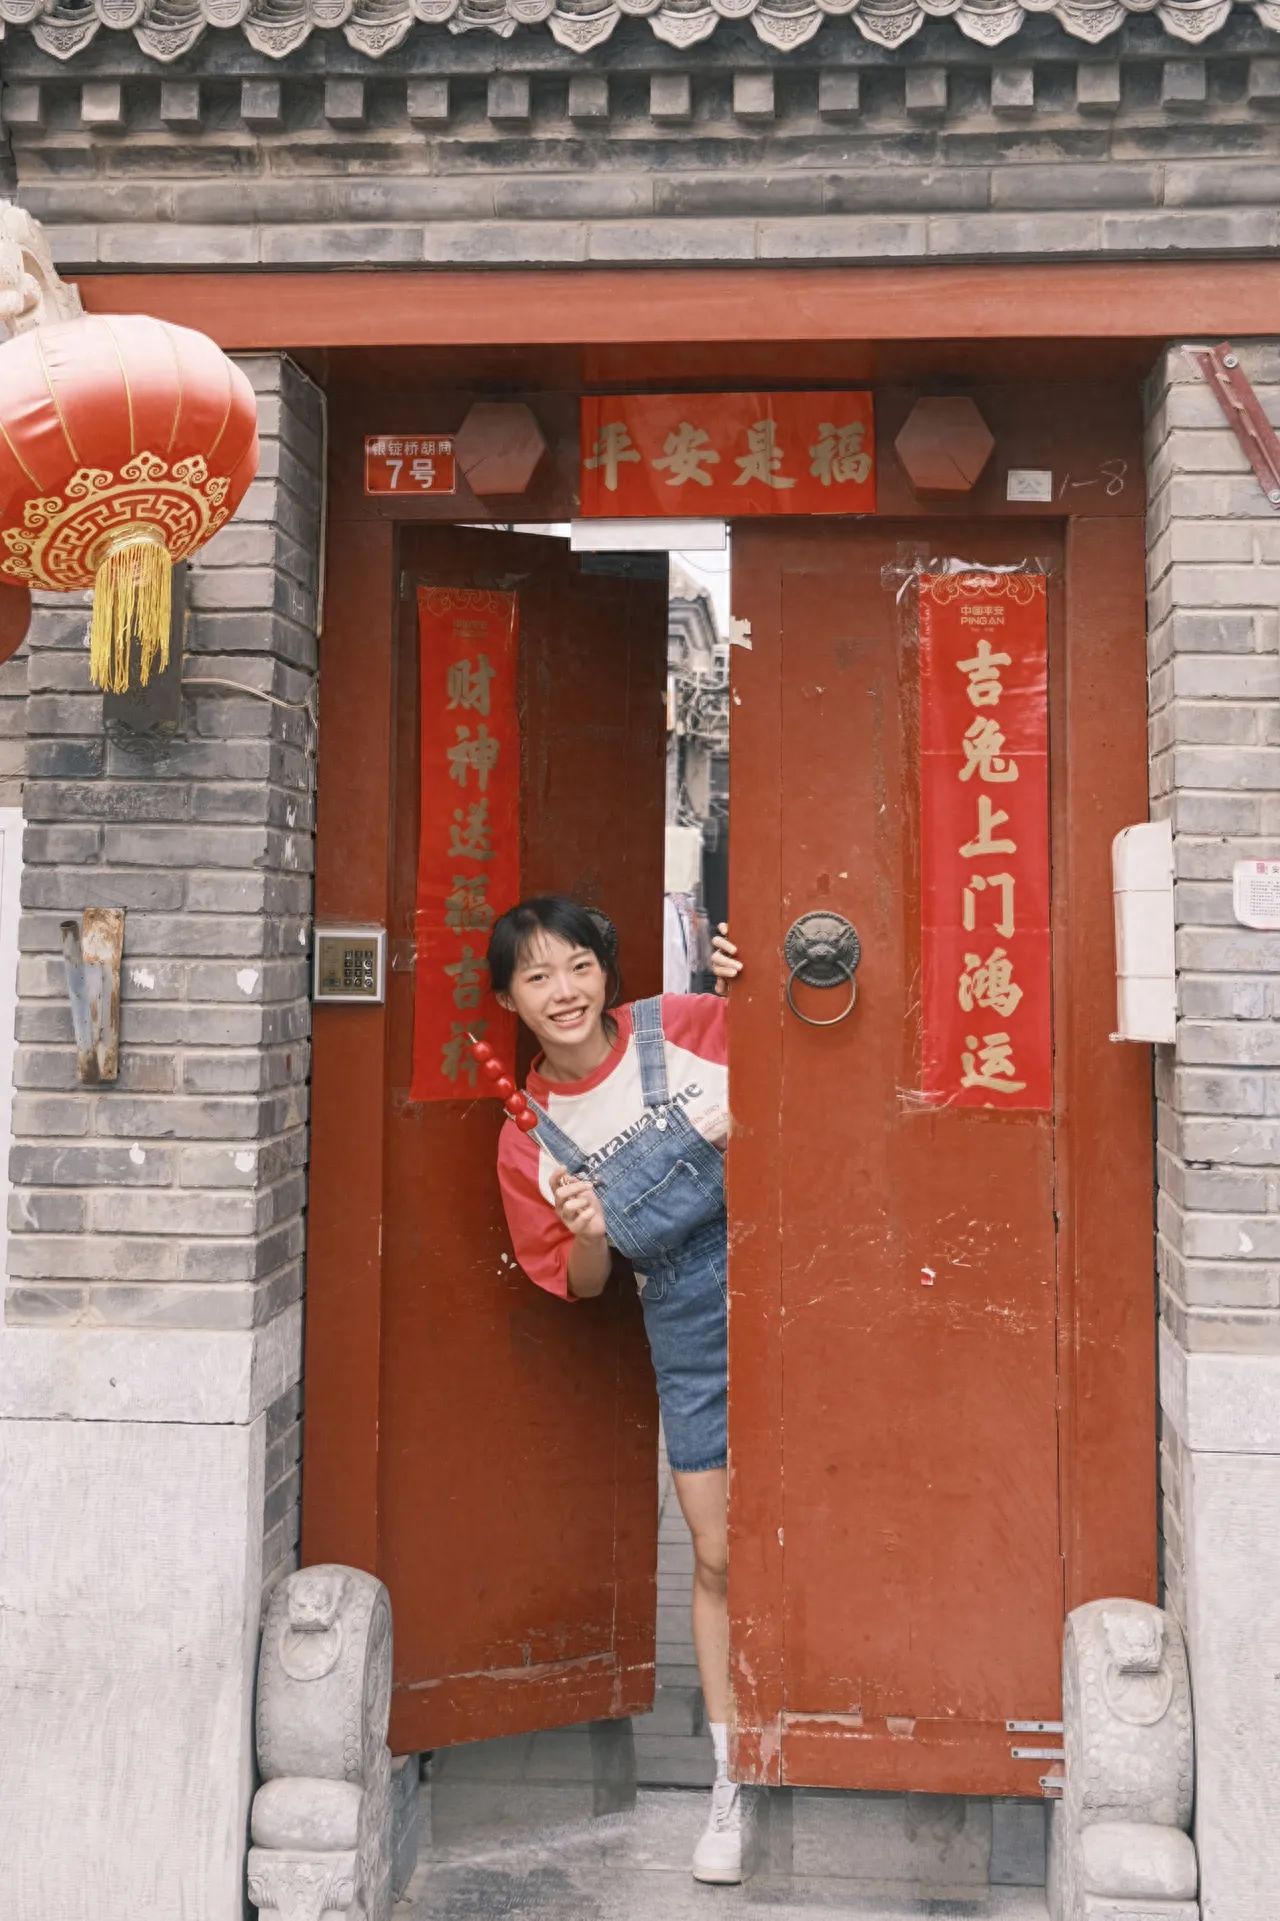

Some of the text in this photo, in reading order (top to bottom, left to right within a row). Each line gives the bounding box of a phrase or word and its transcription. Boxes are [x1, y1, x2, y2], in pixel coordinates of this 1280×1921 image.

[385, 459, 436, 489] 7号
[583, 418, 872, 491] 平安是福
[440, 653, 500, 1089] 财神送福吉祥
[956, 639, 1027, 1108] 吉兔上门鸿运
